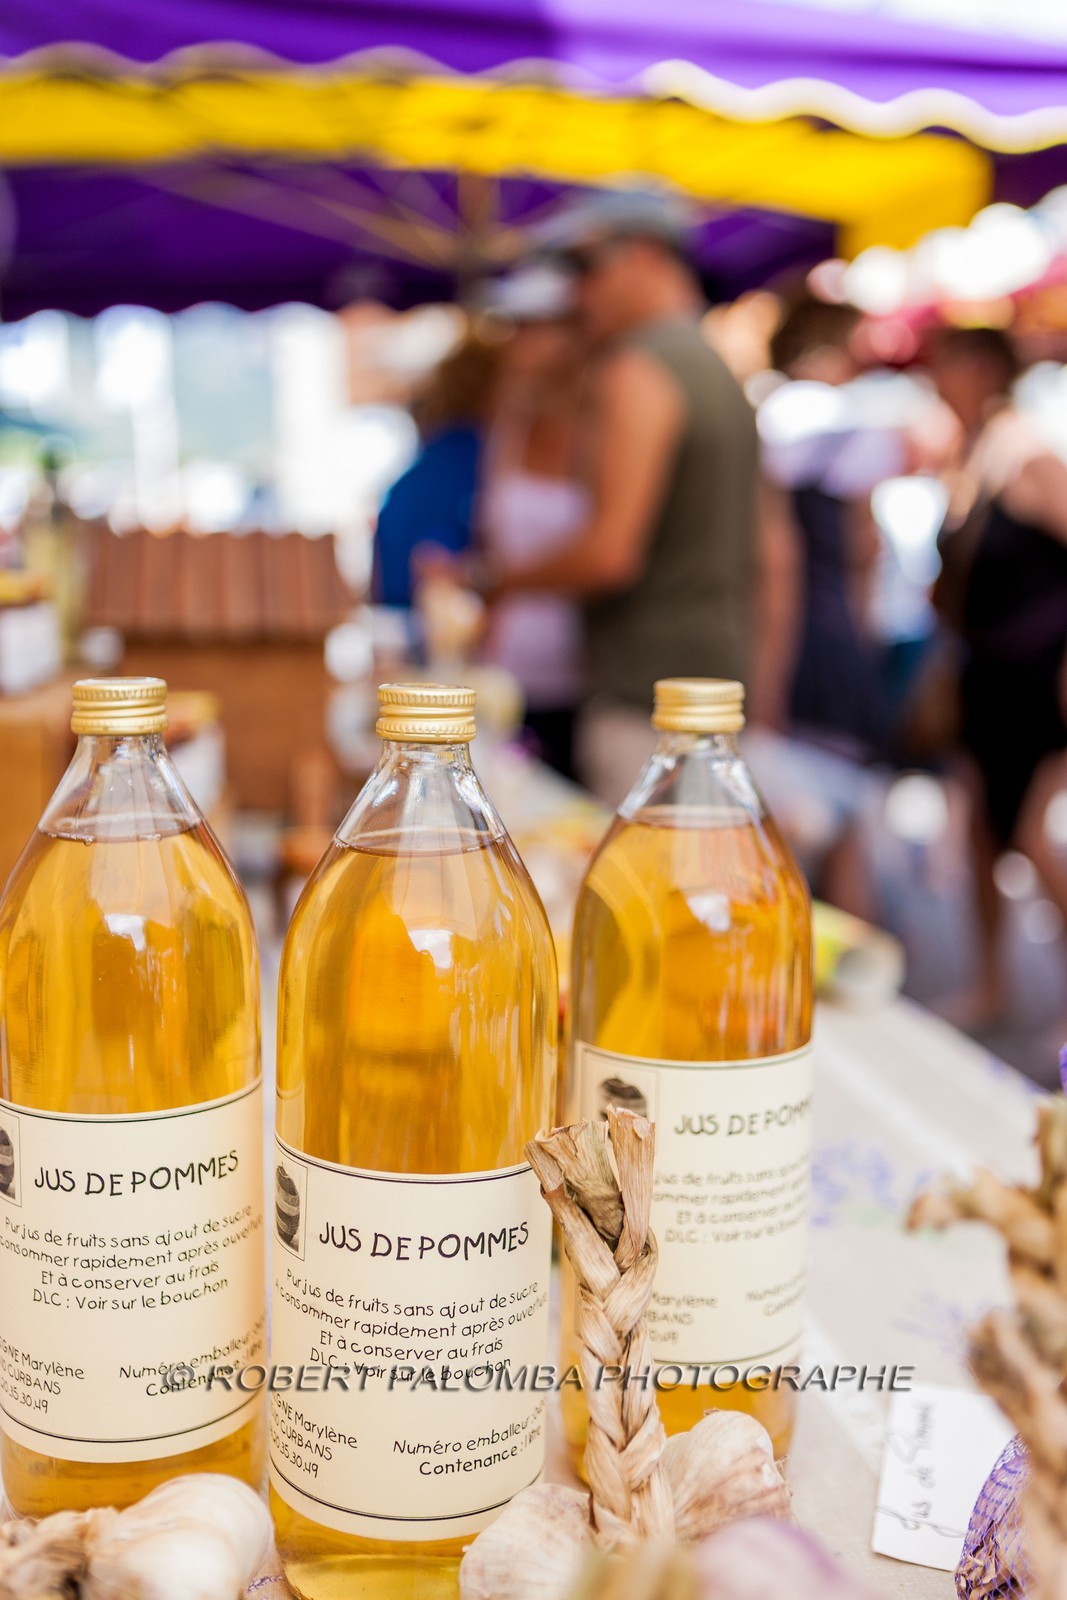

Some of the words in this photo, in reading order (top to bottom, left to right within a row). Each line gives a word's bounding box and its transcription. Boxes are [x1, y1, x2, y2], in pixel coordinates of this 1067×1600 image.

[674, 1113, 719, 1135] JUS
[727, 1112, 760, 1136] DE
[34, 1166, 76, 1192] JUS
[84, 1172, 124, 1196] DE
[130, 1150, 239, 1194] POMMES
[5, 1216, 20, 1234] Pur
[21, 1224, 40, 1240] jus
[44, 1229, 63, 1246] de
[67, 1231, 106, 1248] fruits
[110, 1235, 150, 1248] sans
[155, 1223, 198, 1246] ajout
[202, 1218, 220, 1234] de
[222, 1204, 251, 1228] sucre
[319, 1221, 362, 1252] JUS
[370, 1232, 412, 1261] DE
[418, 1221, 530, 1261] POMMES
[73, 1251, 173, 1271] rapidement
[177, 1240, 219, 1263] après
[41, 1270, 53, 1285] Et
[57, 1273, 68, 1287] à
[71, 1275, 161, 1291] conserver
[165, 1272, 185, 1284] au
[188, 1259, 219, 1279] frais
[33, 1288, 61, 1307] DLC
[75, 1295, 106, 1311] Voir
[111, 1297, 137, 1310] sur
[142, 1295, 156, 1309] le
[160, 1276, 229, 1306] bouchon
[286, 1268, 302, 1288] Pur
[302, 1279, 322, 1298] jus
[325, 1288, 344, 1308] de
[348, 1294, 389, 1315] fruits
[393, 1303, 434, 1317] sans
[439, 1297, 485, 1319] ajout
[489, 1294, 507, 1309] de
[509, 1281, 538, 1304] sucre
[280, 1286, 350, 1329] consommer
[353, 1320, 456, 1339] rapidement
[461, 1316, 504, 1338] après
[320, 1329, 333, 1346] Et
[336, 1335, 347, 1350] à
[350, 1342, 443, 1361] conserver
[447, 1348, 468, 1360] au
[472, 1337, 503, 1356] frais
[8, 1363, 61, 1396] CURBANS
[21, 1351, 85, 1380] Marylène
[119, 1360, 186, 1379] Numéro
[310, 1347, 338, 1369] DLC
[353, 1360, 387, 1379] Voir
[390, 1366, 417, 1382] sur
[421, 1366, 436, 1383] le
[440, 1357, 511, 1380] bouchon
[280, 1419, 333, 1461] CURBANS
[294, 1410, 358, 1449] Marylène
[393, 1438, 462, 1456] Numéro
[419, 1445, 518, 1476] Contenance
